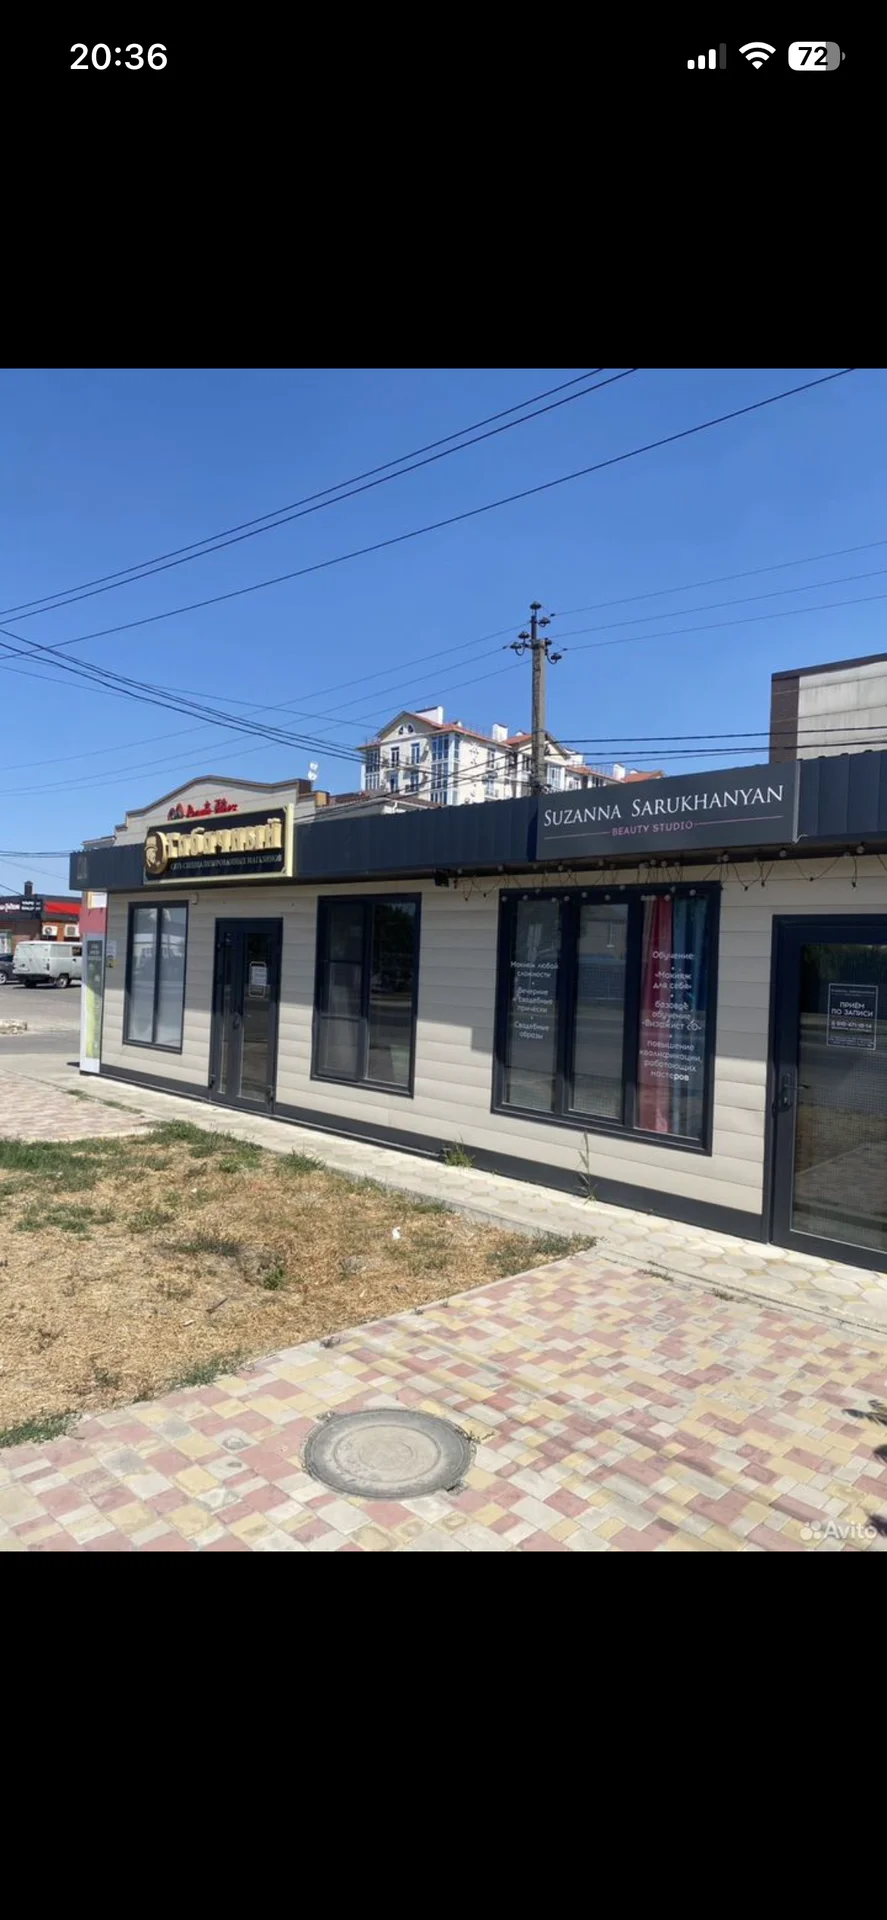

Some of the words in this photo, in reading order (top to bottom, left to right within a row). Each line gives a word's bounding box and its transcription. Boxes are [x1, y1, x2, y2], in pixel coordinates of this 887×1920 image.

[543, 804, 622, 827] SUZANNA
[631, 785, 783, 818] SARUKHANYAN
[611, 824, 650, 837] BEAUTY
[652, 820, 694, 833] STUDIO
